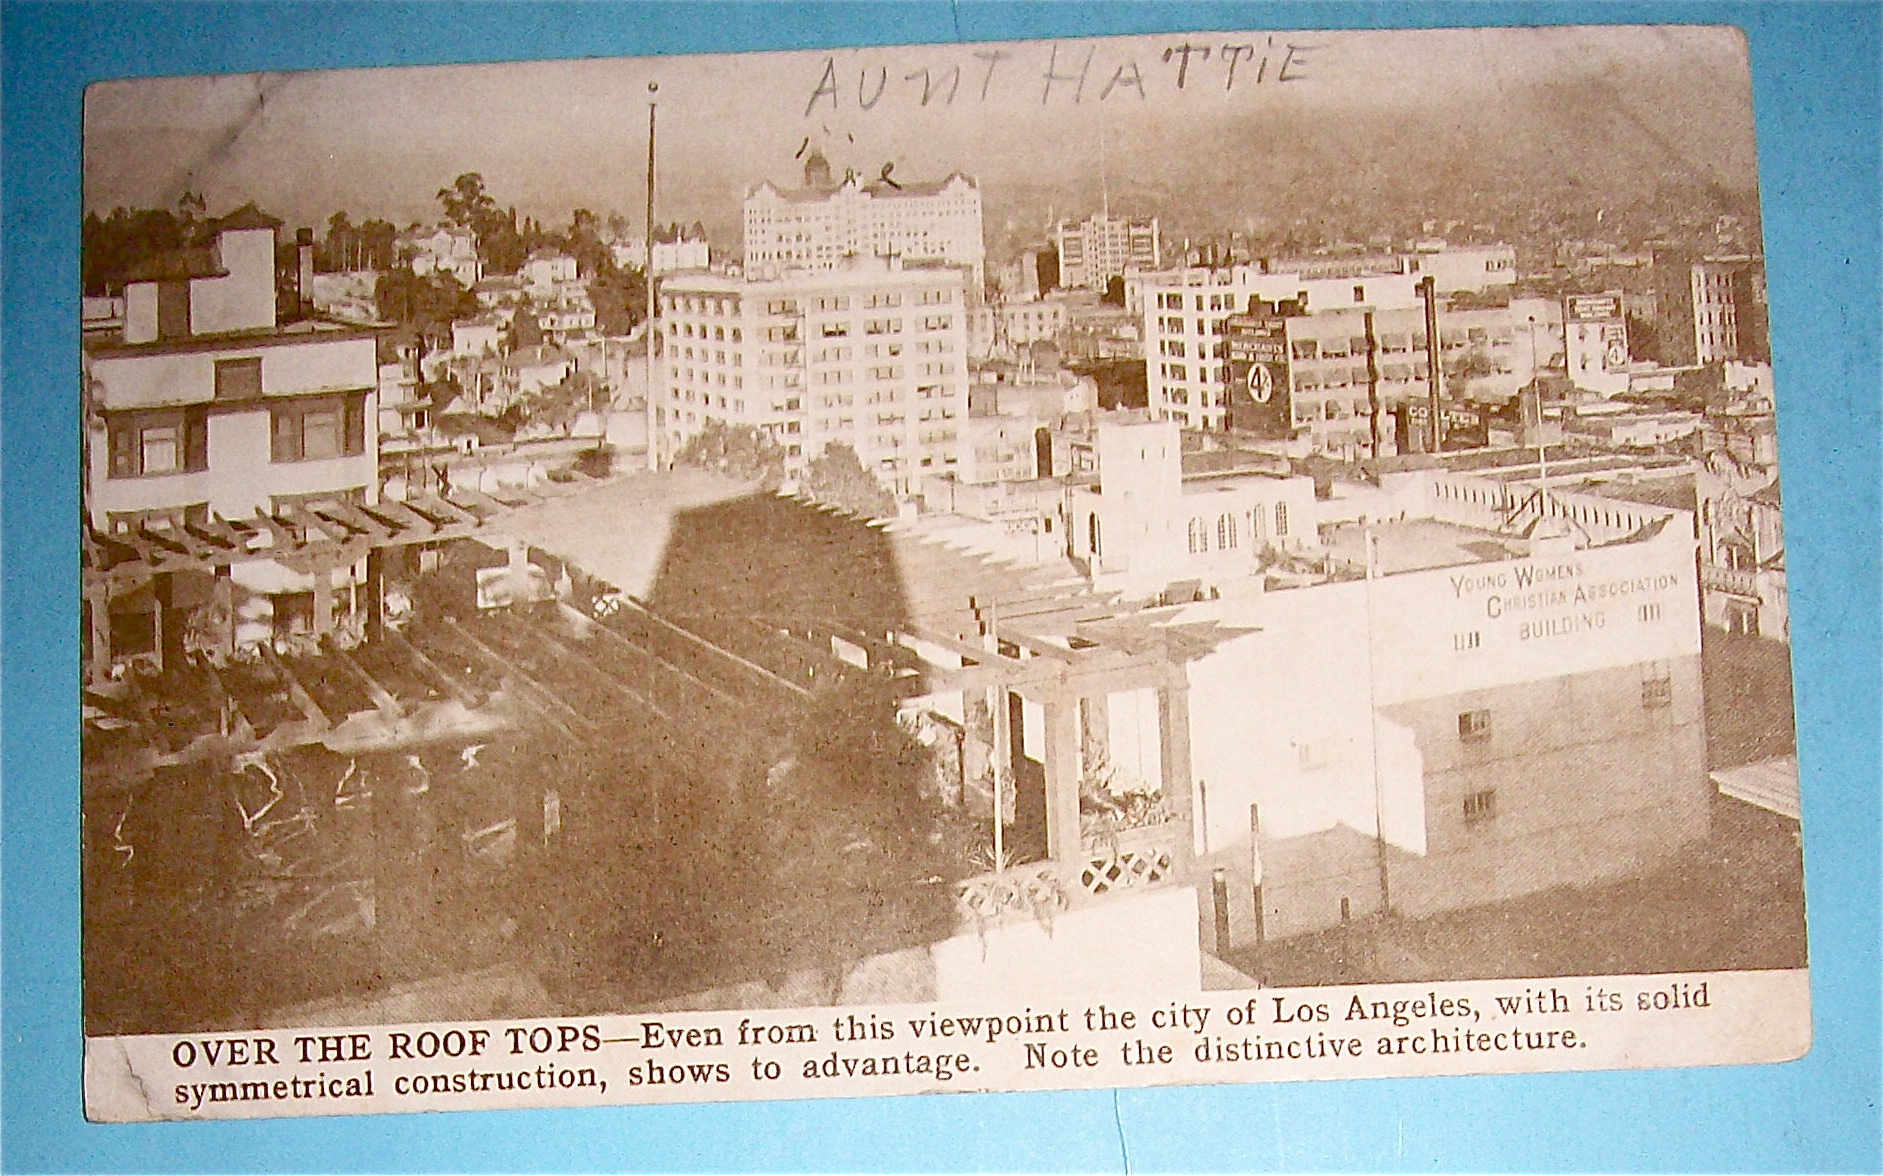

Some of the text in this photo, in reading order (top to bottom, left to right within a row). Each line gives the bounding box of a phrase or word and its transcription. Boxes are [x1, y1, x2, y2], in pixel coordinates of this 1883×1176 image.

[1450, 573, 1507, 598] YOUNG
[1487, 574, 1678, 619] CHRISTIAN ASSOCIATION
[1520, 612, 1605, 641] BUILDING
[172, 1037, 280, 1068] OVER
[293, 1032, 373, 1063] THE
[388, 1028, 491, 1060] ROOF
[738, 1017, 817, 1046] from
[833, 1014, 895, 1042] this
[908, 1006, 1070, 1044] viewpoint
[1083, 1004, 1137, 1032] the
[1151, 1002, 1211, 1035] city
[1226, 998, 1257, 1027] of
[1272, 995, 1330, 1024] Los
[1344, 992, 1481, 1028] Angeles,
[1495, 987, 1570, 1016] with
[1585, 987, 1624, 1013] its
[1637, 982, 1712, 1012] solid
[175, 1025, 1587, 1111] symmetrical construction, shows to advantage. Note the distinctive architecture.
